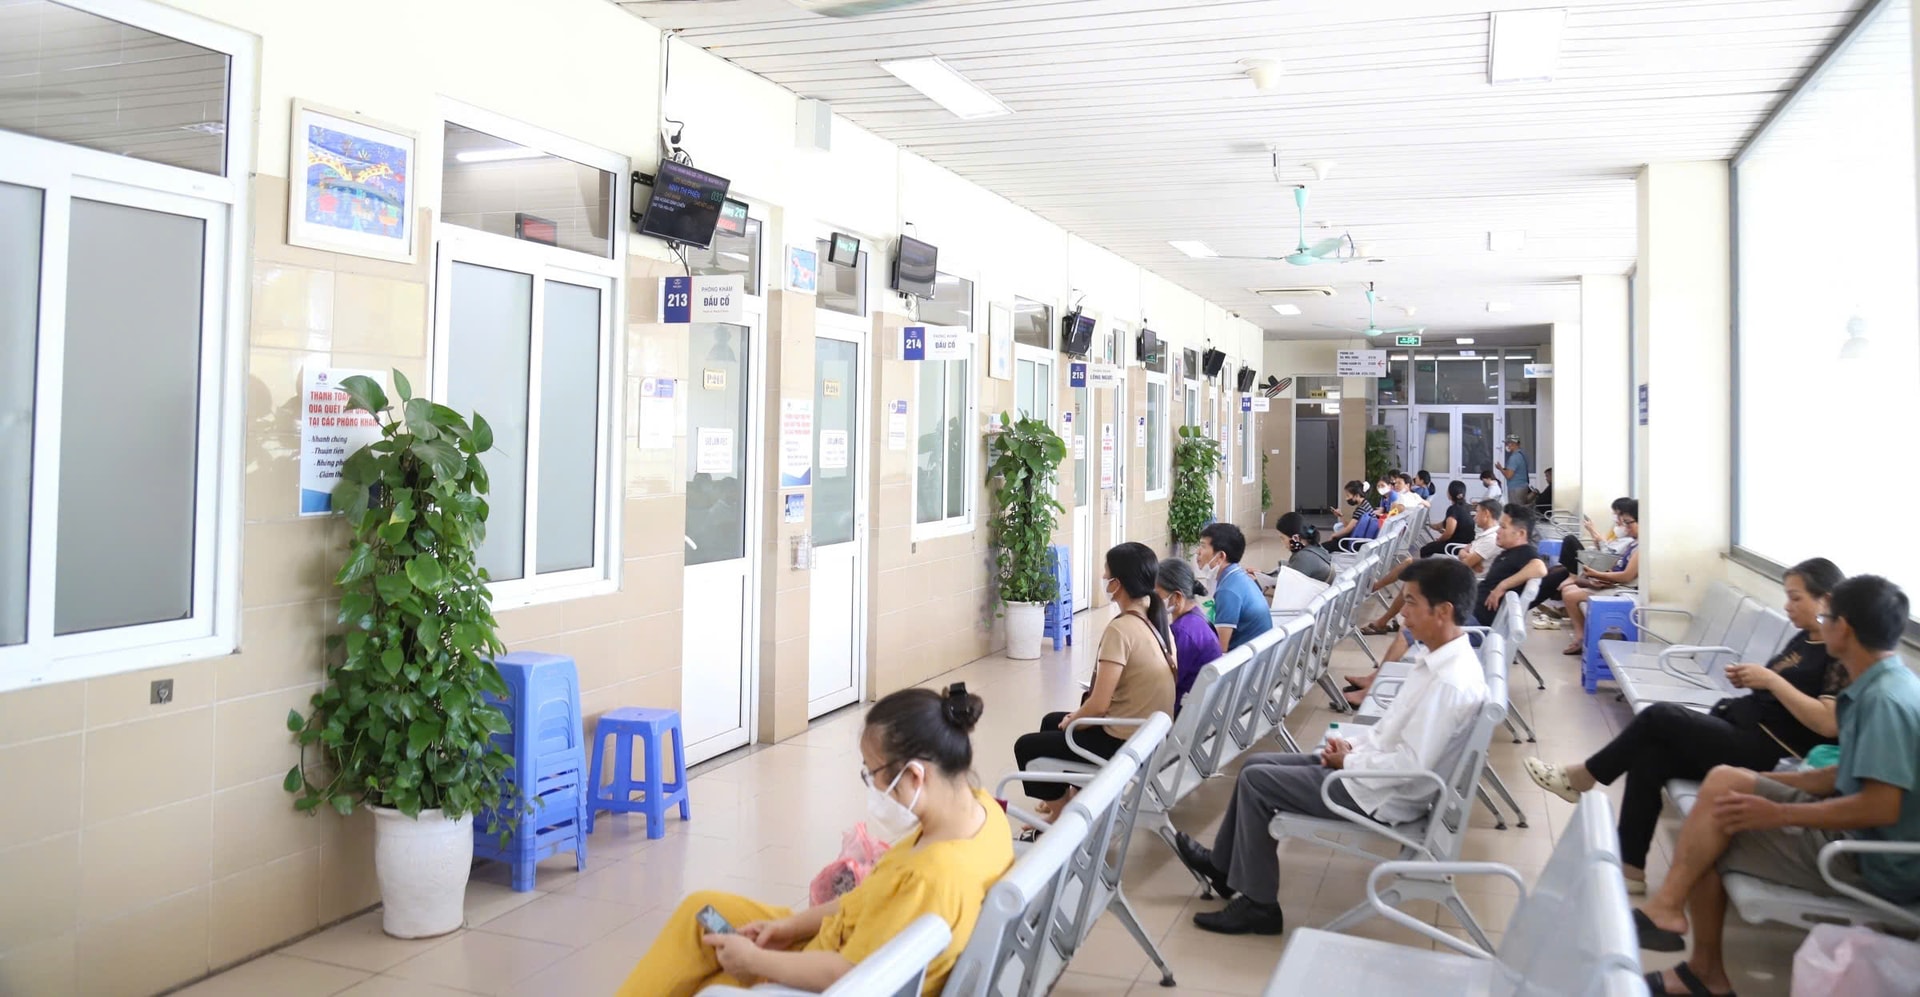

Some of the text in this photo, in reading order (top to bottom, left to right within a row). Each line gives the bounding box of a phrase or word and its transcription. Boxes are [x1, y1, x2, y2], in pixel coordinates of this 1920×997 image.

[667, 293, 688, 307] 213
[905, 339, 922, 349] 214
[1072, 371, 1084, 379] 215
[310, 391, 333, 401] THANH
[308, 404, 322, 414] QUA
[308, 417, 320, 428] TẠI
[321, 416, 335, 427] CÁC
[337, 416, 359, 427] PHÒNG
